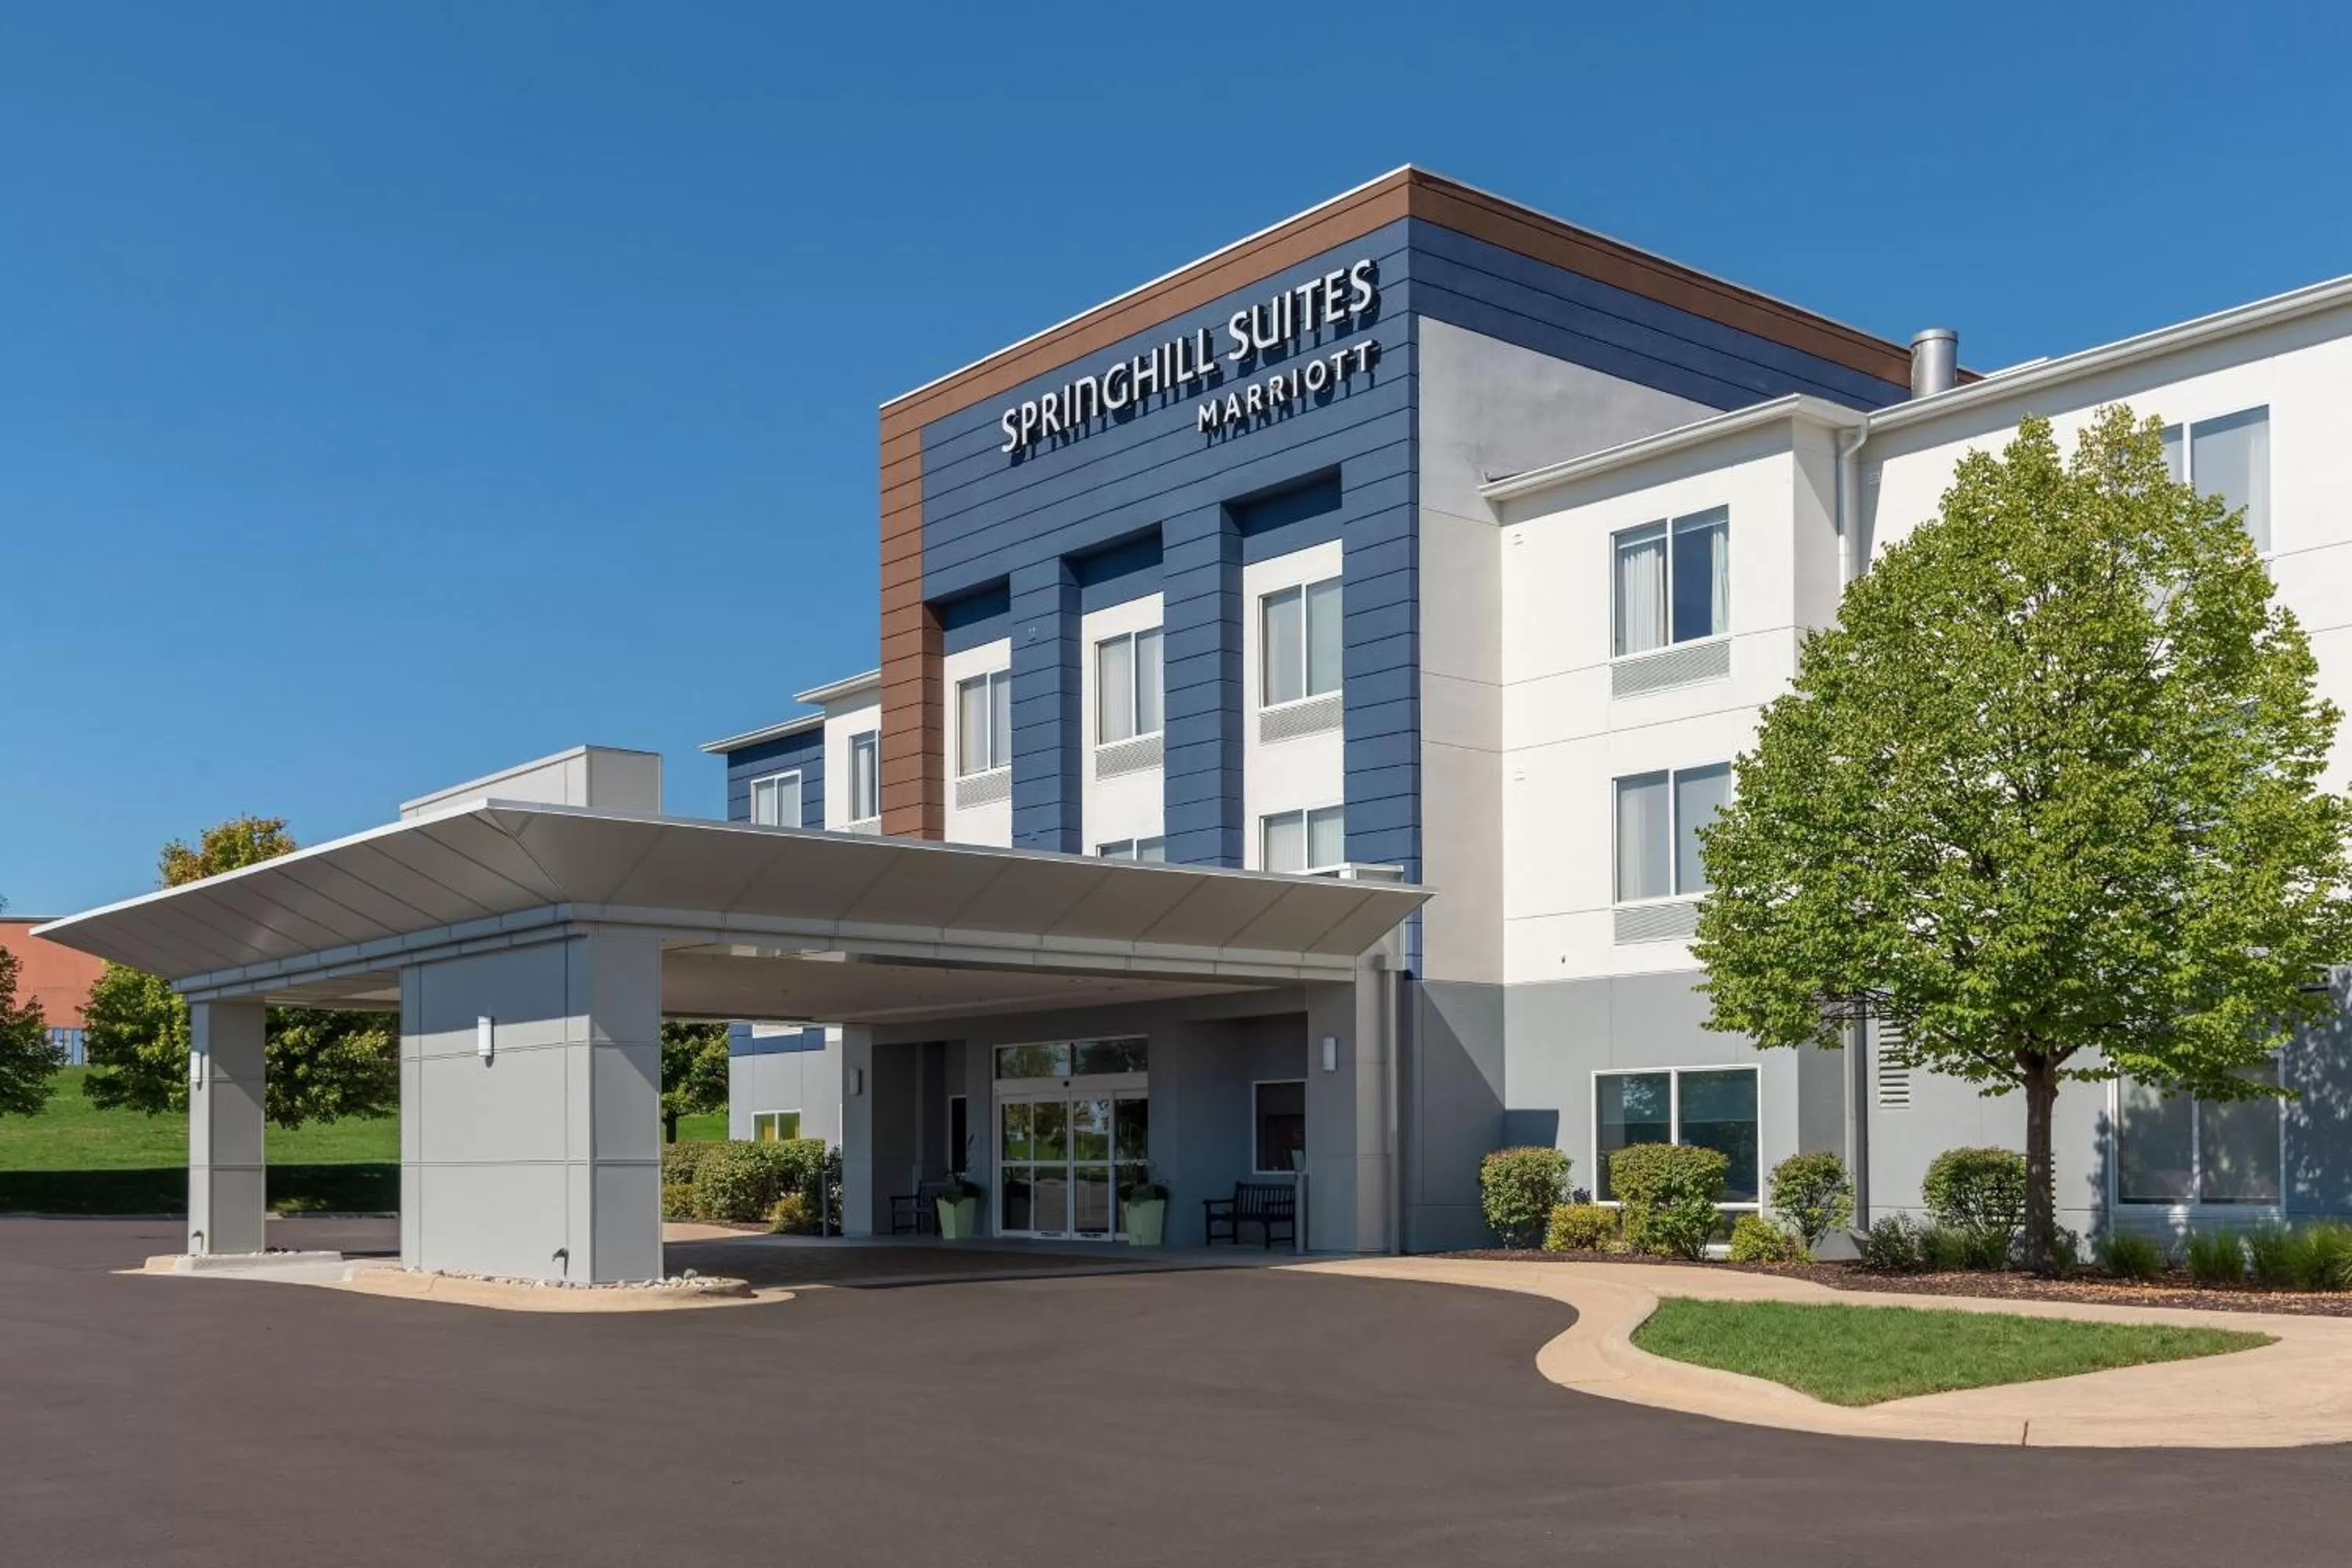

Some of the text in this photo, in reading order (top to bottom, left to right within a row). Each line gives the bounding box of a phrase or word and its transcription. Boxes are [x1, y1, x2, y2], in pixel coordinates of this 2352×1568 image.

[1001, 259, 1375, 453] SPRINGHILL SUITES
[1198, 339, 1377, 433] MARRIOTT
